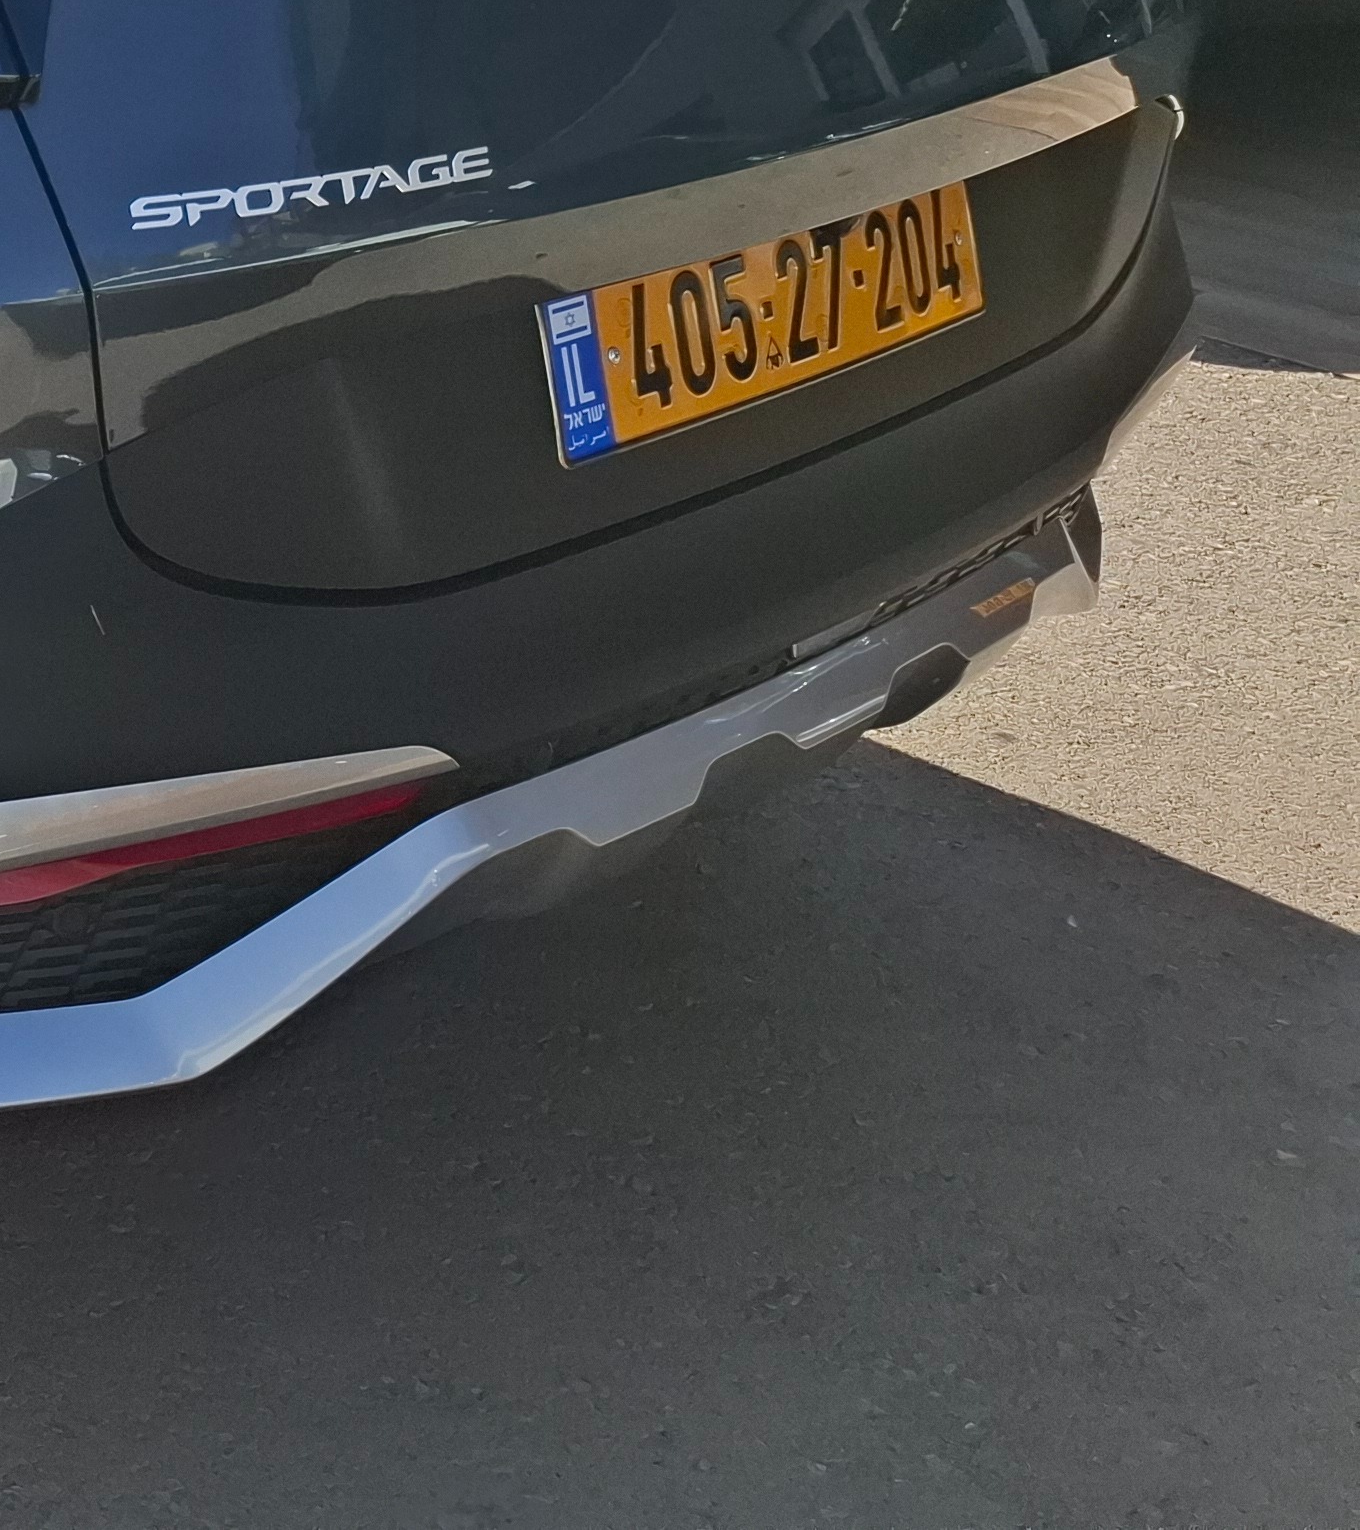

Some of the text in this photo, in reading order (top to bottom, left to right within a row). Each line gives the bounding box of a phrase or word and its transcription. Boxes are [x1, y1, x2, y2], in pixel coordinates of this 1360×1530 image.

[129, 146, 494, 230] SPORTAGE
[561, 343, 596, 407] IL
[563, 403, 606, 431] ישראל
